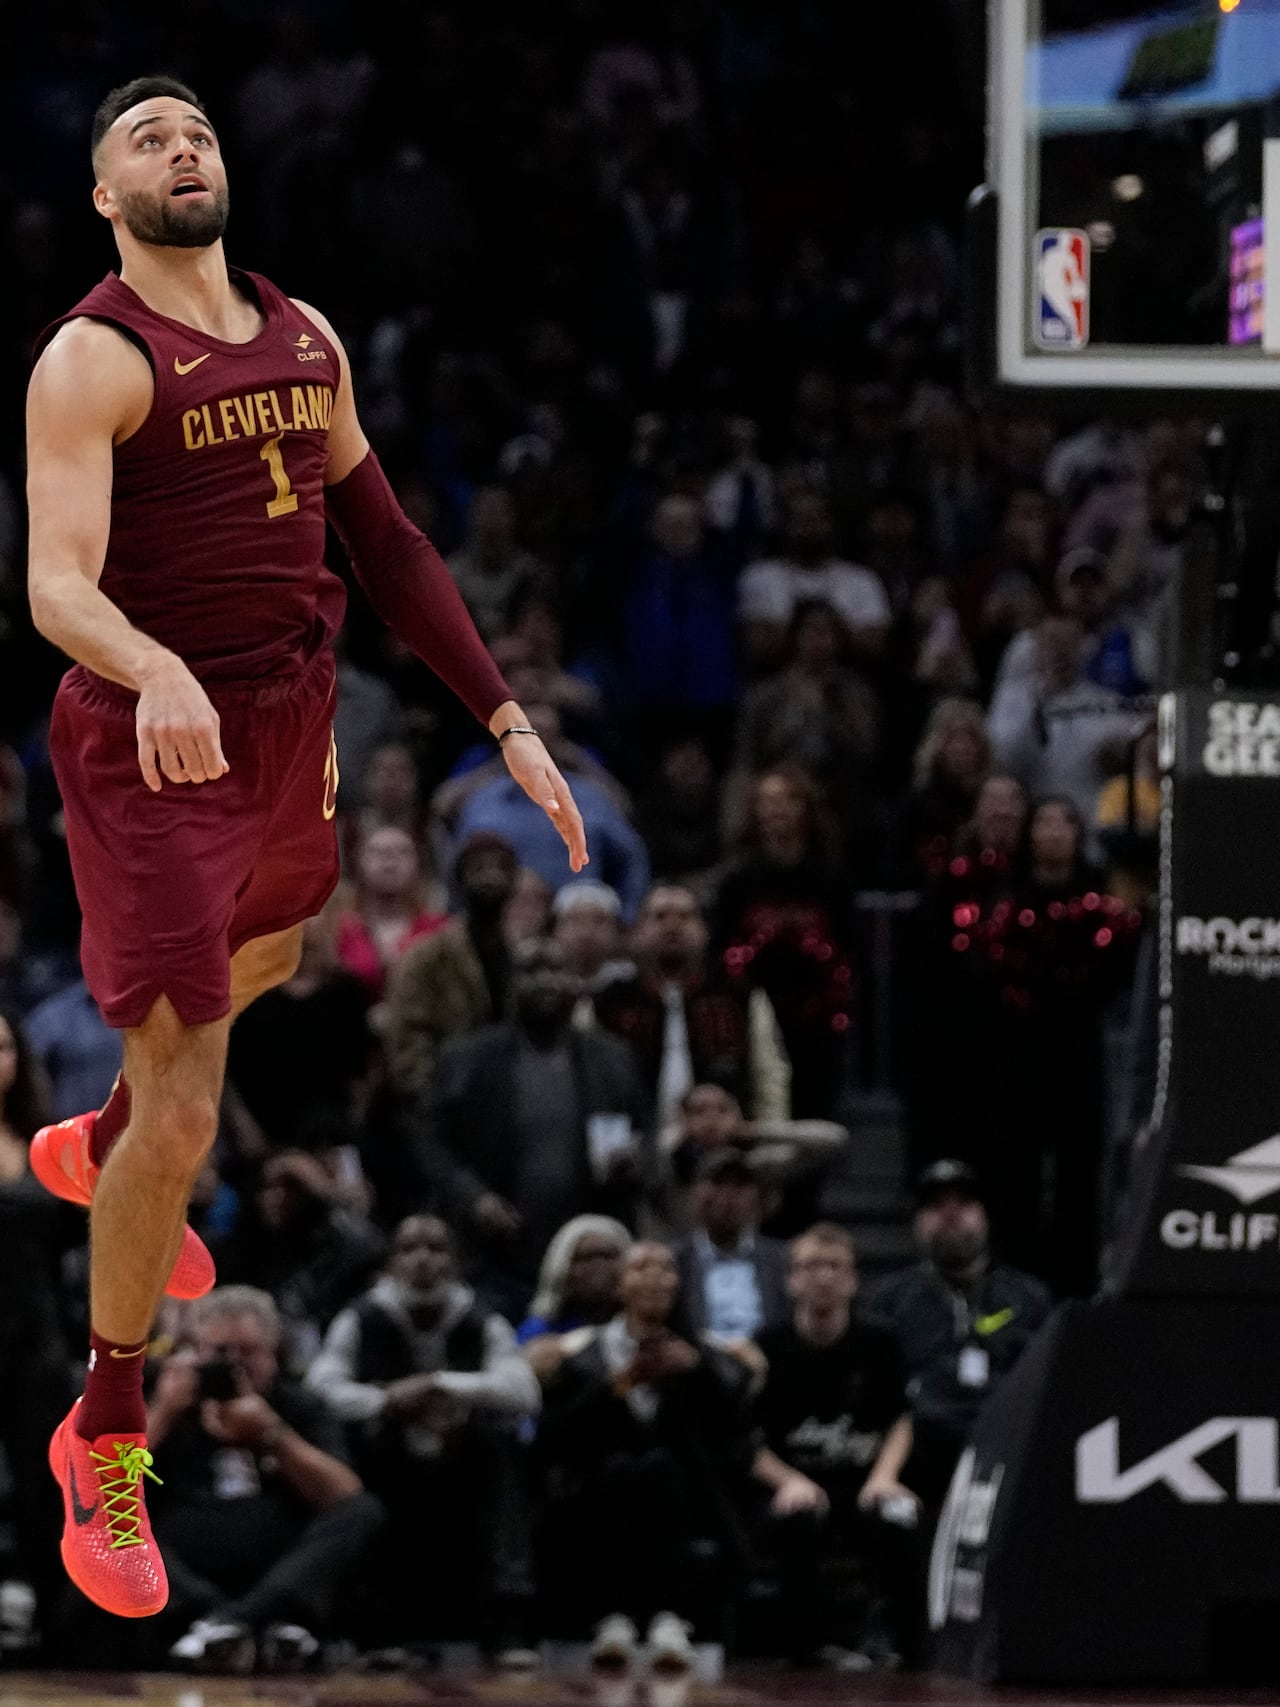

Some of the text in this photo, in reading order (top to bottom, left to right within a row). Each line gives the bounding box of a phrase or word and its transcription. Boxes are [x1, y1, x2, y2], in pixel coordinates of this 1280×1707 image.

[297, 350, 328, 362] CLIFFS
[181, 384, 333, 450] CLEVELAND
[260, 431, 299, 519] 1
[1160, 1209, 1280, 1250] CLIF
[1075, 1415, 1280, 1503] KI
